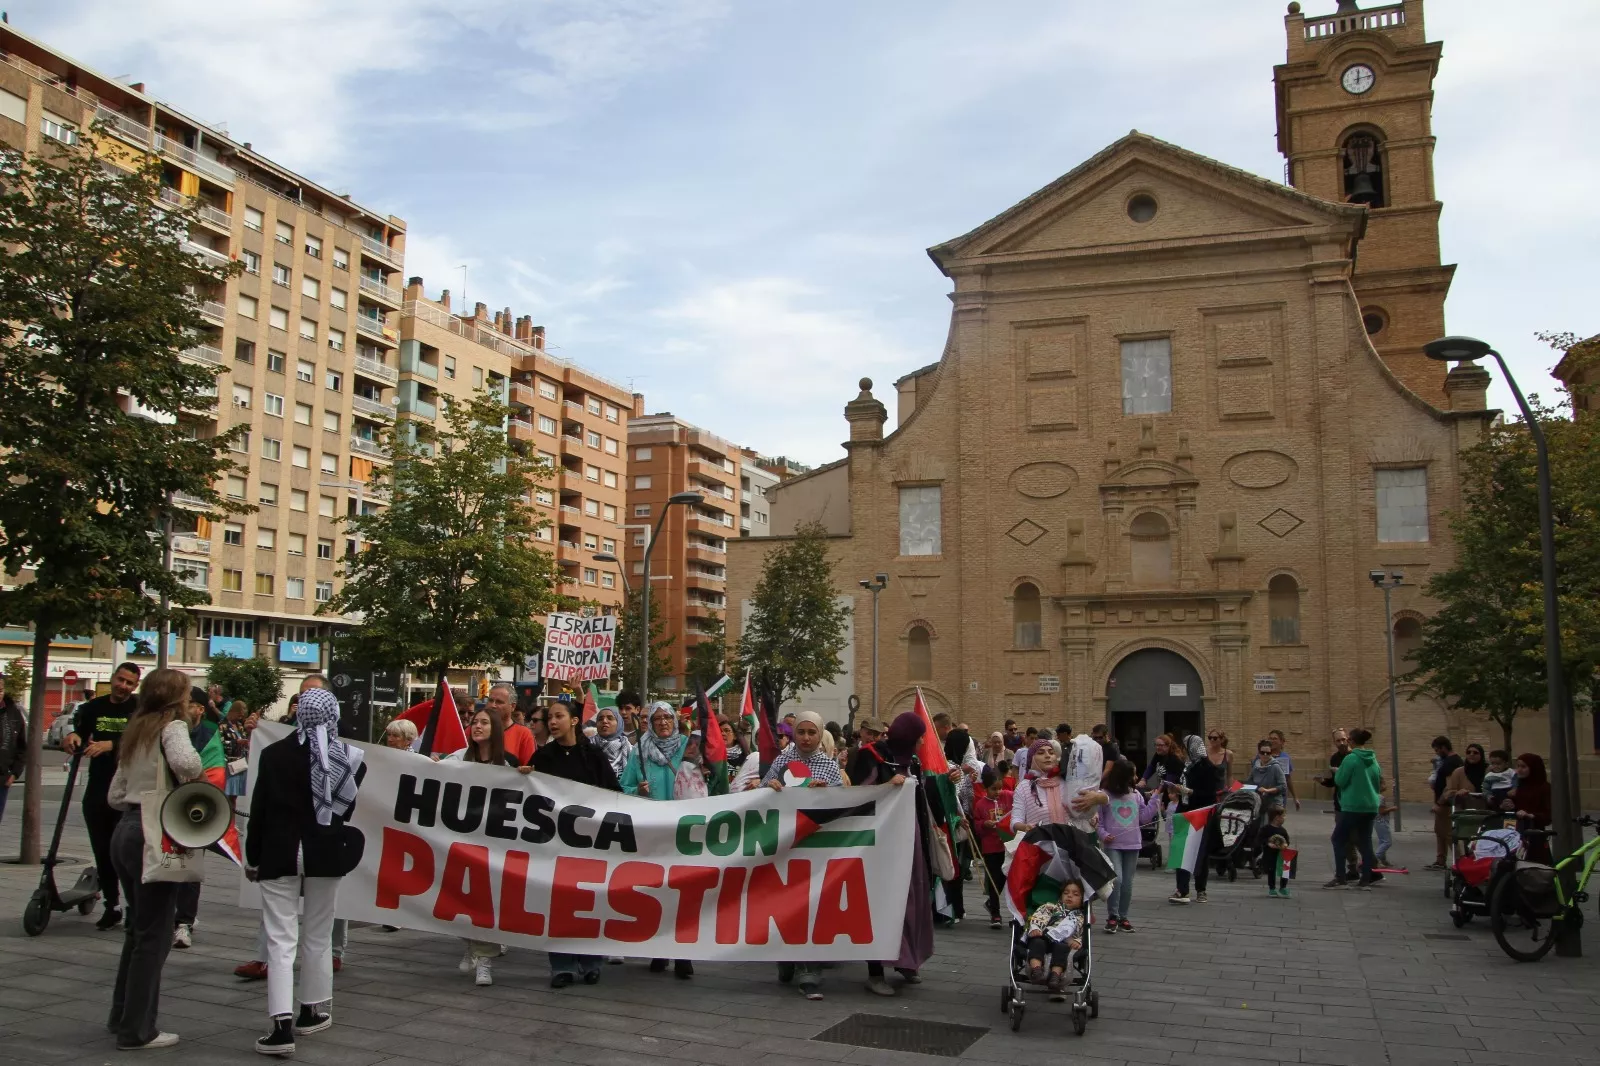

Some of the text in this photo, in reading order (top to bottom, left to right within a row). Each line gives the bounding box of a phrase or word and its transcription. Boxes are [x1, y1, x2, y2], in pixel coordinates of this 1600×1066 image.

[549, 614, 613, 634] ISRAEL
[547, 629, 612, 648] GENOCIDA
[546, 645, 600, 665] EUROPA
[545, 662, 608, 681] PATROCINA
[393, 773, 780, 857] HUESCA CON
[375, 826, 874, 945] PALESTINA
